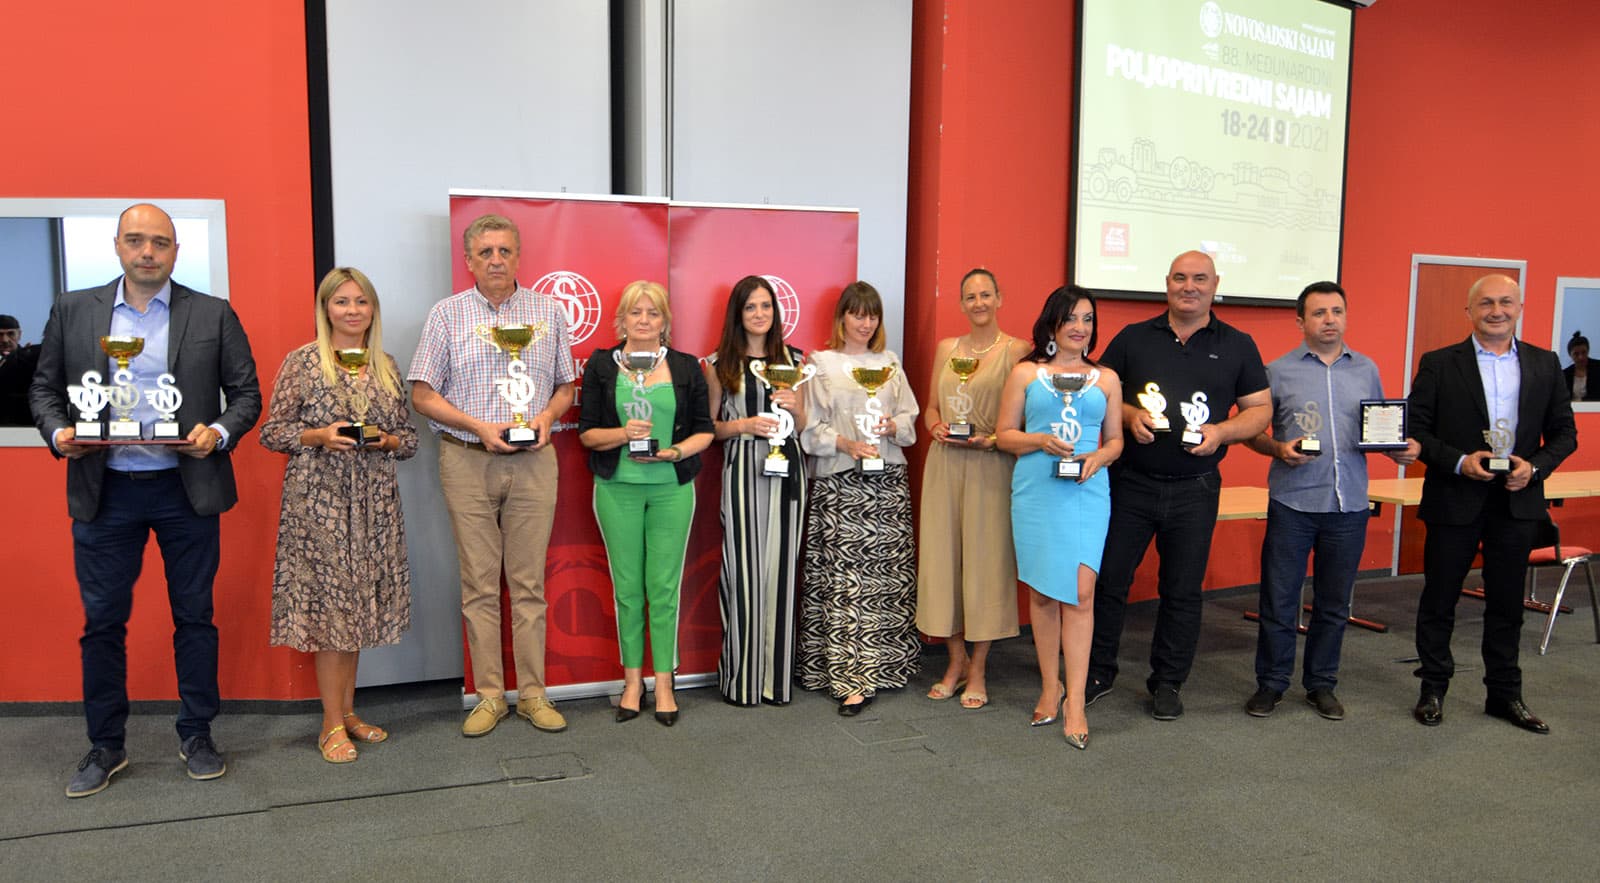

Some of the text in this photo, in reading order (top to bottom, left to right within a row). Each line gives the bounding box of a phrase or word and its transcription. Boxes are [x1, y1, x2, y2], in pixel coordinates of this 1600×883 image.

[1224, 12, 1336, 60] NOVOSADSKI SAJAM
[1105, 43, 1332, 120] POLJOPRIVREDNI SAJAM
